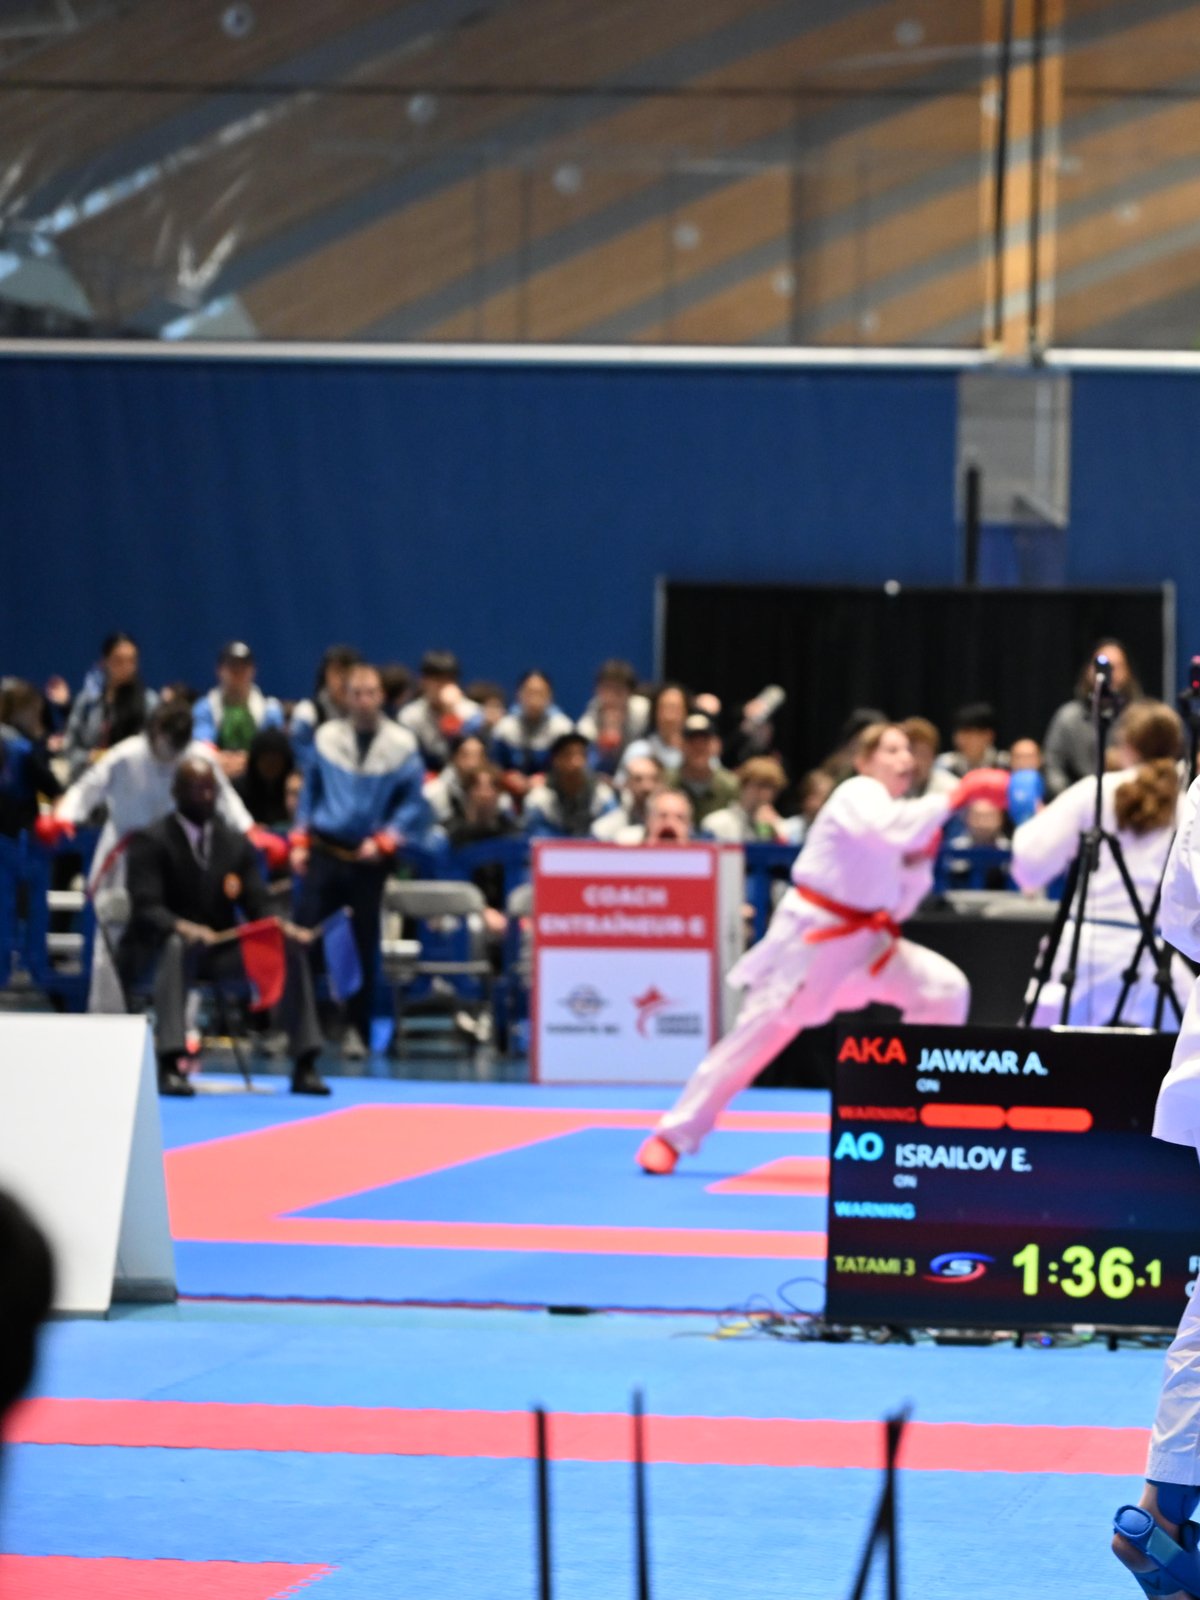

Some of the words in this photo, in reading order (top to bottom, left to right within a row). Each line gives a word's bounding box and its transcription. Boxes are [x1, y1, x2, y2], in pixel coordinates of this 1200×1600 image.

[582, 885, 669, 908] COACH
[838, 1036, 908, 1065] AKA
[917, 1048, 1019, 1074] JAWKAR
[1022, 1051, 1049, 1076] A.
[838, 1105, 917, 1123] WARNING
[834, 1131, 884, 1162] AO
[895, 1143, 1007, 1171] ISRAILOV
[1011, 1147, 1033, 1172] E.
[834, 1201, 916, 1220] WARNING
[834, 1256, 900, 1275] TATAMI
[903, 1258, 916, 1276] 3
